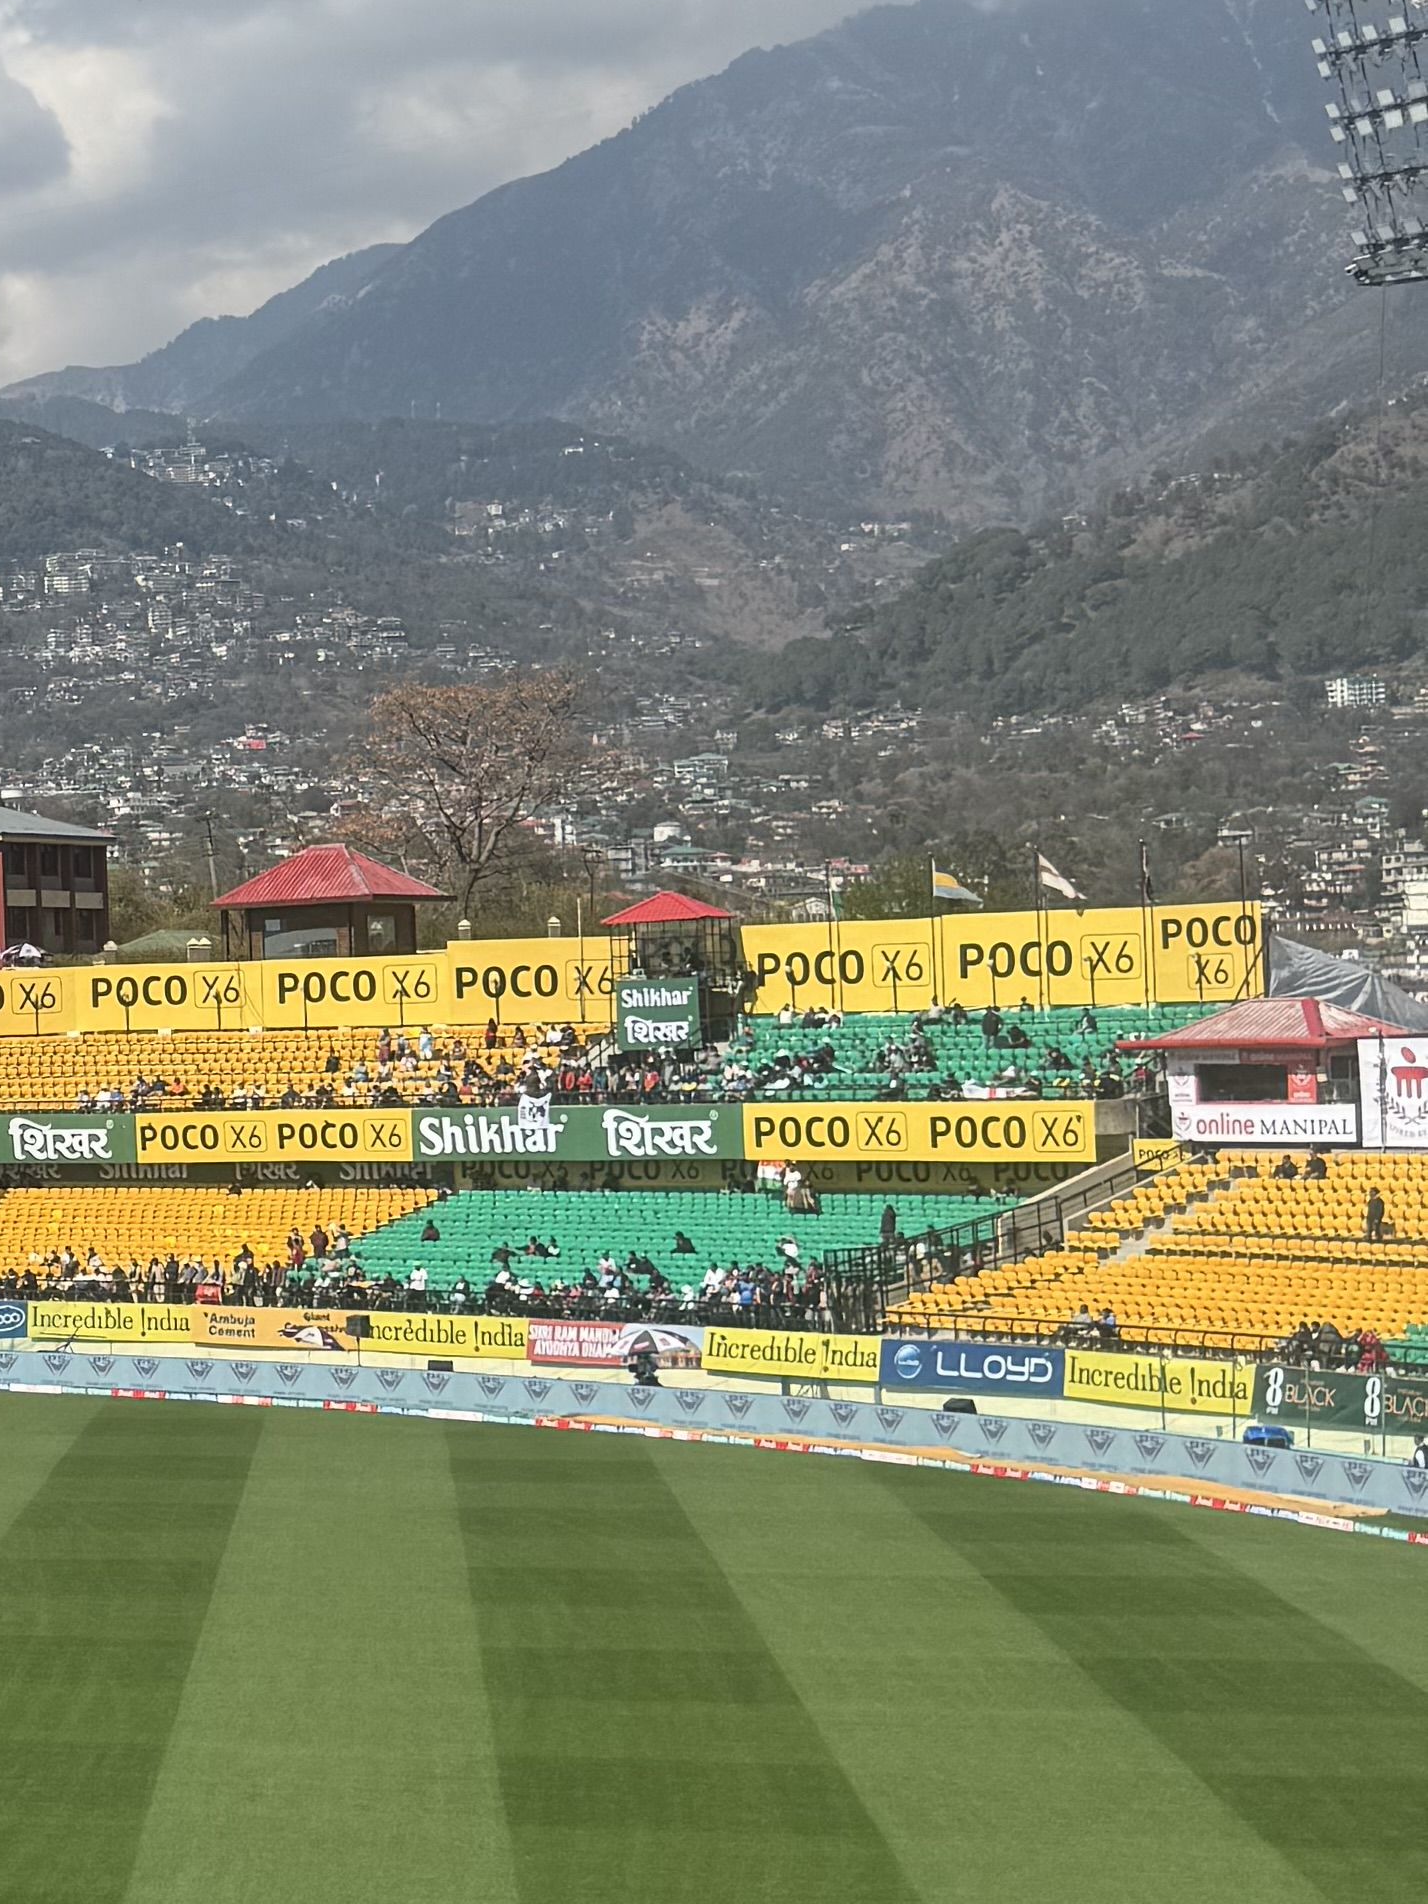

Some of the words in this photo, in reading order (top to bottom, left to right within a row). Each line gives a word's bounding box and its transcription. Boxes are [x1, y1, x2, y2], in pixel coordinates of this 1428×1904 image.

[1161, 915, 1257, 950] POCO
[758, 949, 865, 987] POCO
[879, 949, 924, 983] X6
[959, 940, 1073, 979] POCO
[1090, 940, 1135, 976] X6
[1195, 957, 1229, 985] X6
[20, 982, 56, 1010] X6
[92, 975, 187, 1008] POCO
[201, 975, 240, 1004] X6
[278, 969, 376, 1004] POCO
[391, 969, 431, 999] X6
[455, 964, 559, 999] POCO
[574, 965, 614, 996] X6
[621, 987, 692, 1009] Shikhar
[624, 1015, 690, 1044] शिखर
[8, 1116, 113, 1161] शिखर
[140, 1122, 219, 1151] POCO
[231, 1125, 263, 1148] X6
[278, 1120, 359, 1150] POCO
[371, 1123, 403, 1148] X6
[419, 1112, 565, 1156] Shikhar
[602, 1108, 718, 1157] शिखर
[754, 1115, 850, 1147] POCO
[864, 1115, 903, 1147] X6
[930, 1114, 1027, 1149] POCO
[1040, 1114, 1080, 1147] X6
[1196, 1112, 1255, 1136] online
[1259, 1118, 1353, 1136] MANIPAL
[32, 1305, 134, 1331] Incredible
[208, 1325, 256, 1339] Cement
[369, 1318, 466, 1346] ncredible
[707, 1331, 816, 1365] Incredible
[936, 1351, 1054, 1383] LLOYD
[1068, 1354, 1183, 1395] Incredible
[1265, 1367, 1284, 1407] 8
[1285, 1384, 1337, 1408] BLACK
[1364, 1376, 1381, 1418] 8
